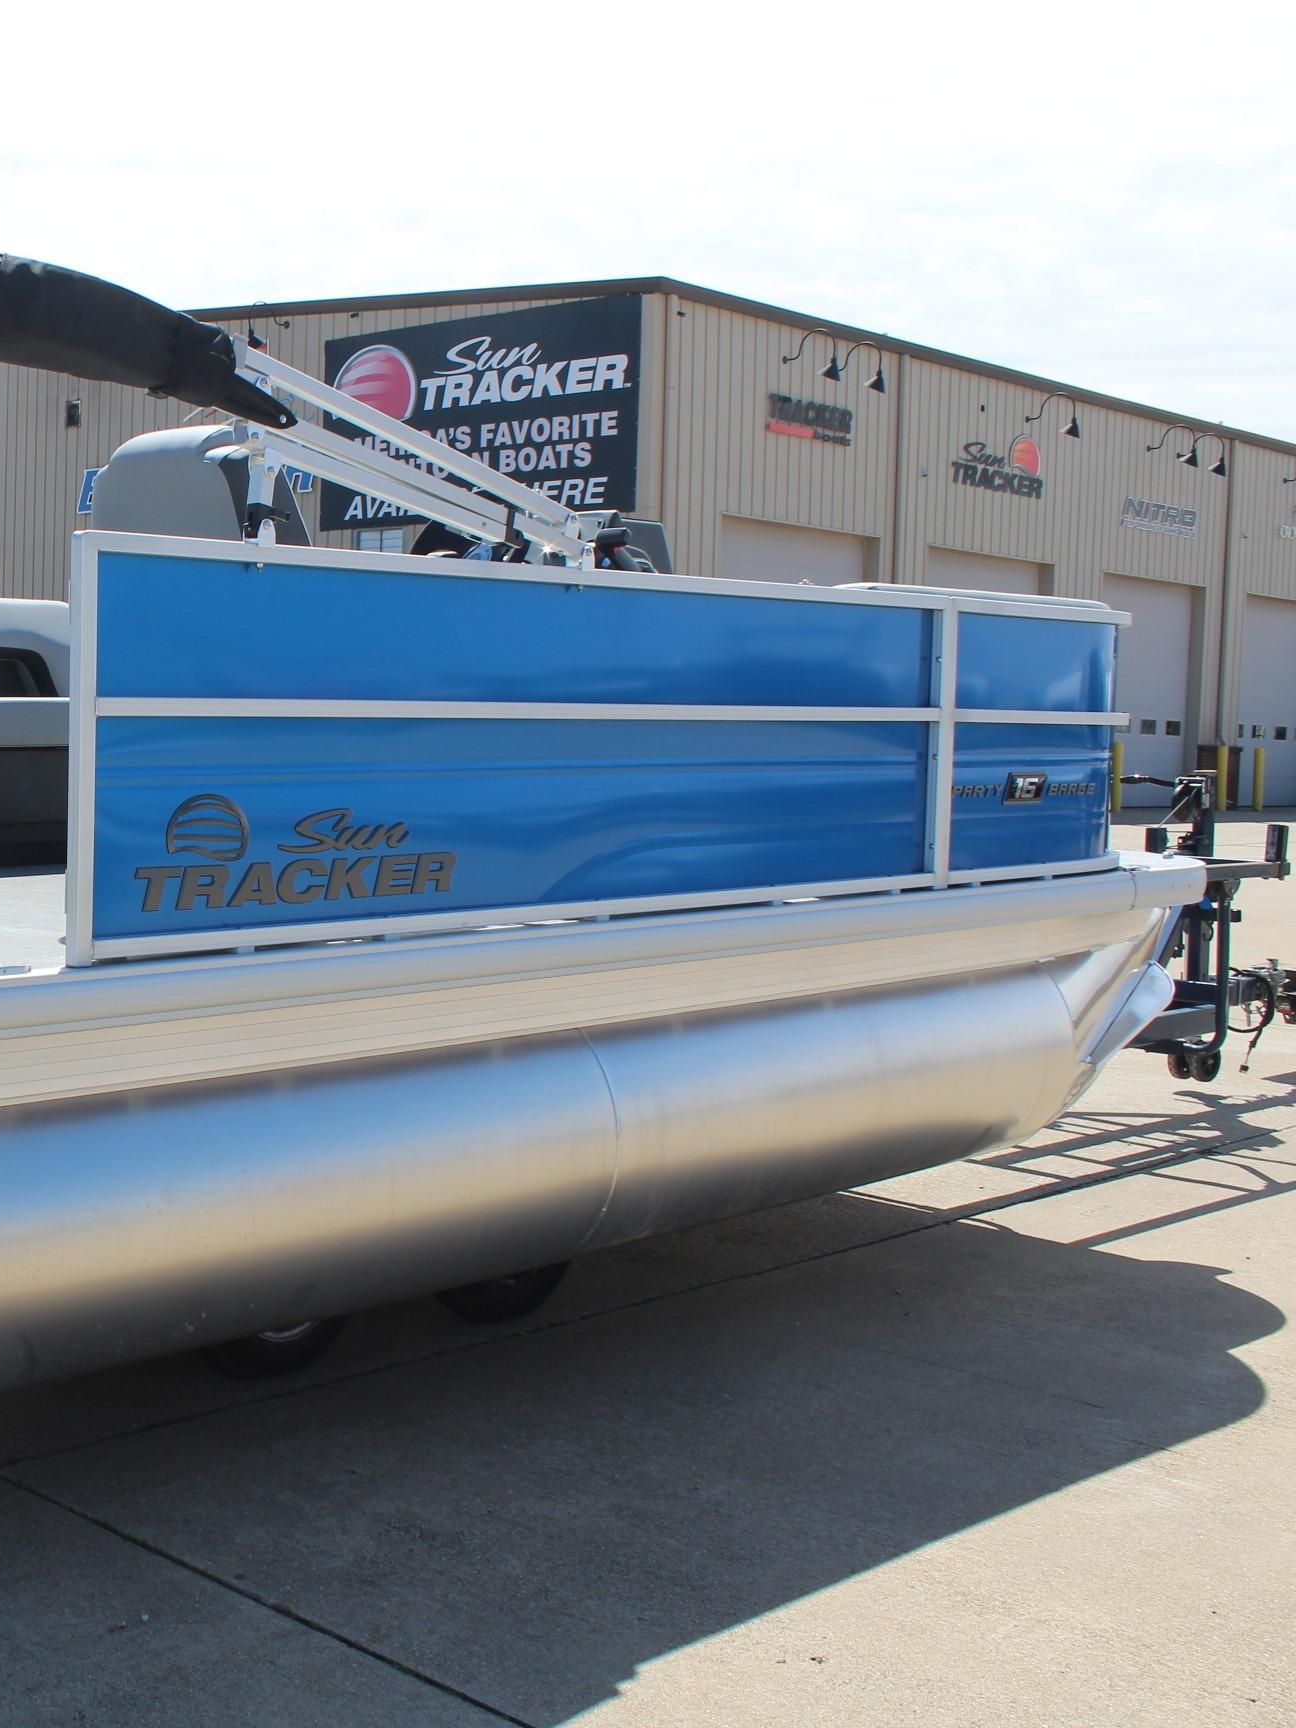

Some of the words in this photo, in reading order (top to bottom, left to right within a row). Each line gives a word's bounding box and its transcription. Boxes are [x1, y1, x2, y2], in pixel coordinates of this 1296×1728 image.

[433, 336, 541, 375] Sun
[420, 354, 628, 411] TRACKER
[480, 410, 619, 448] FAVORITE
[768, 392, 852, 434] TRACKER
[498, 441, 592, 474] BOATS
[958, 441, 1007, 469] Sun
[951, 461, 1043, 499] TRACKER
[1121, 496, 1199, 530] NITRO
[951, 784, 1004, 798] PARTY
[1048, 782, 1096, 796] BARGE
[277, 808, 410, 854] Sun
[134, 851, 456, 912] TRACKER
